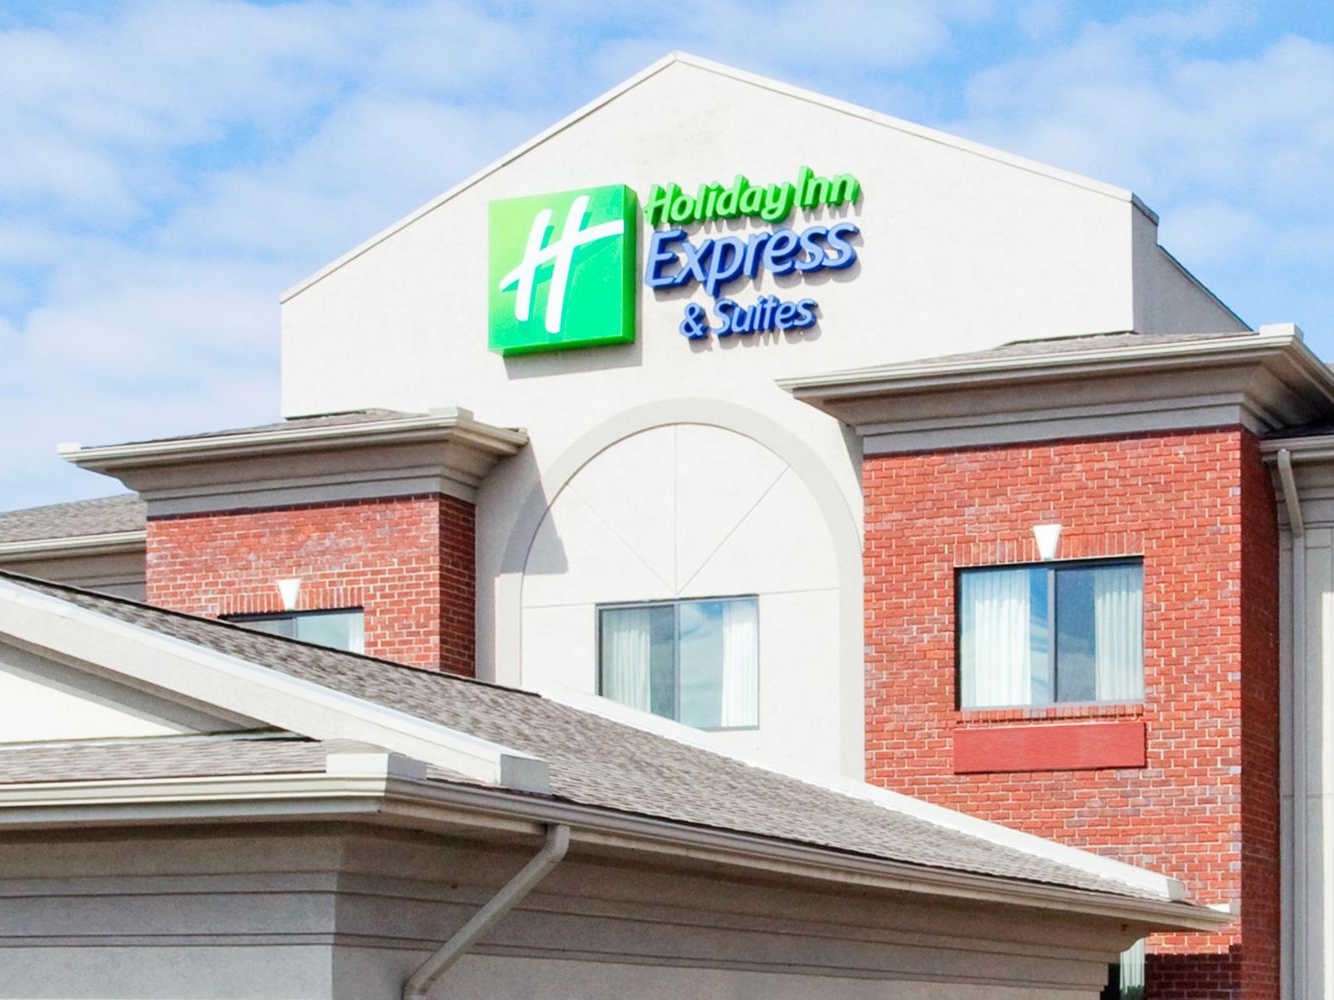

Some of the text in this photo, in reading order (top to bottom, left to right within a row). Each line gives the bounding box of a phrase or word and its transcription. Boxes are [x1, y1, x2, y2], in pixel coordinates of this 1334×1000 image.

[644, 165, 861, 226] Holiday Inn
[645, 222, 860, 298] Express
[679, 295, 818, 339] & Suites
